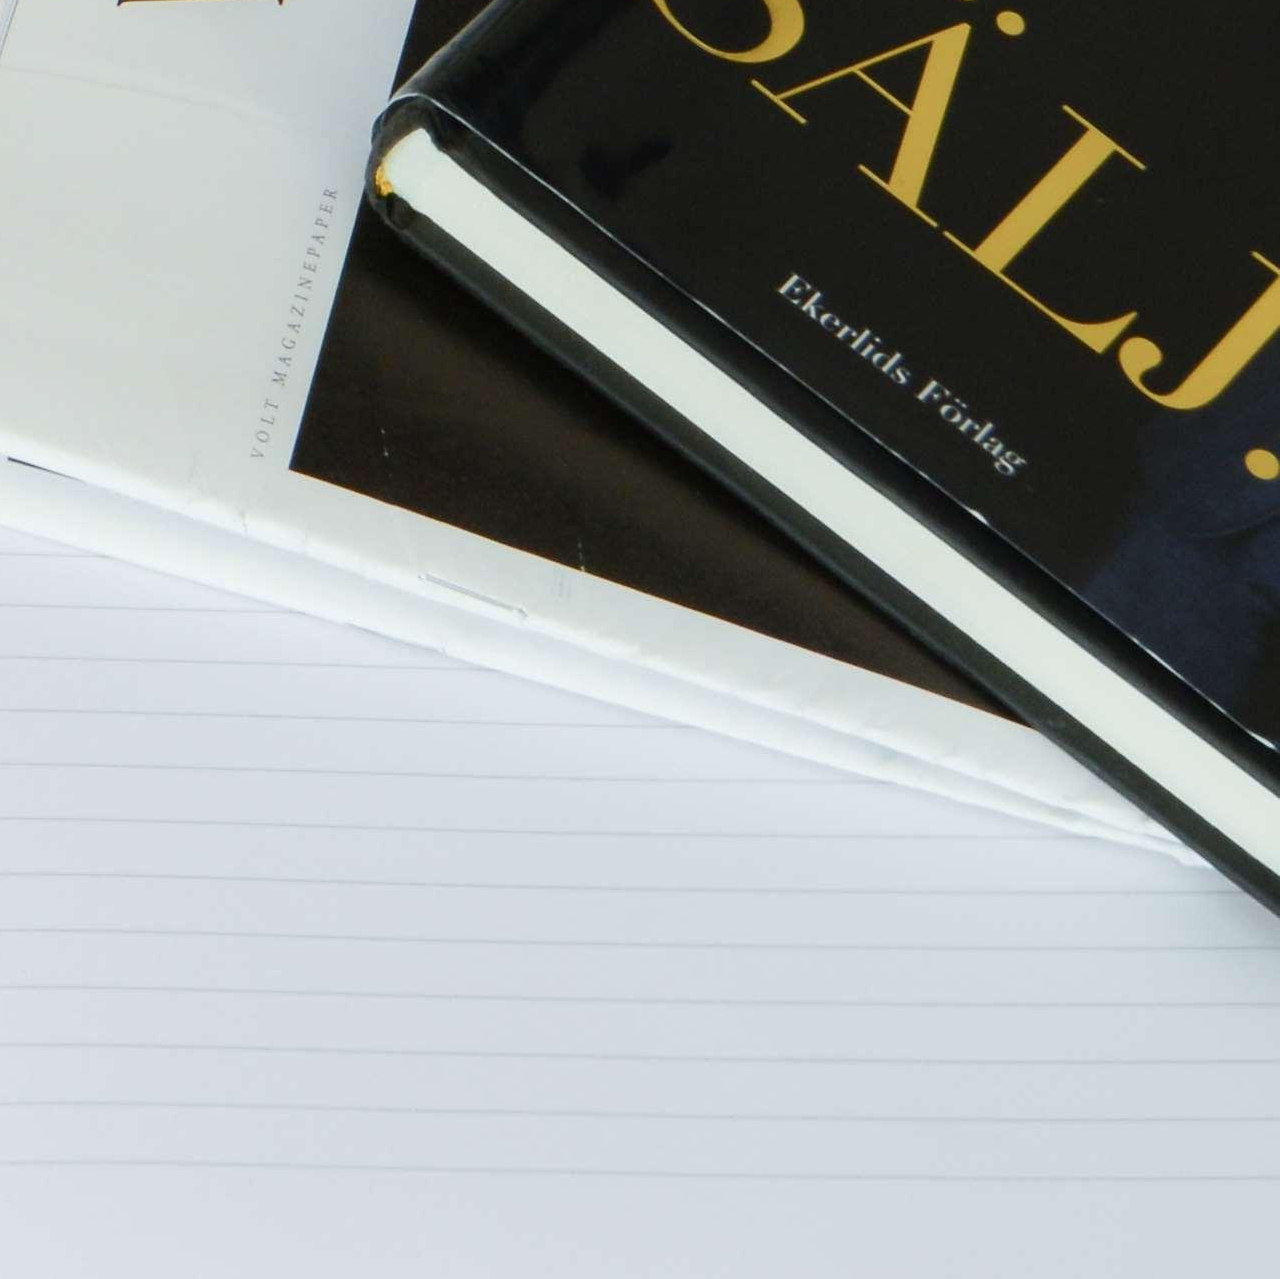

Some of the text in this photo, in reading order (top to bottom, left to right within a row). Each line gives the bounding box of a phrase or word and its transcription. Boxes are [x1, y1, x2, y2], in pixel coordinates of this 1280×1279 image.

[250, 186, 339, 461] VOLT MAGAZINEPAPER
[776, 272, 1027, 478] Ekerlids Förlag
